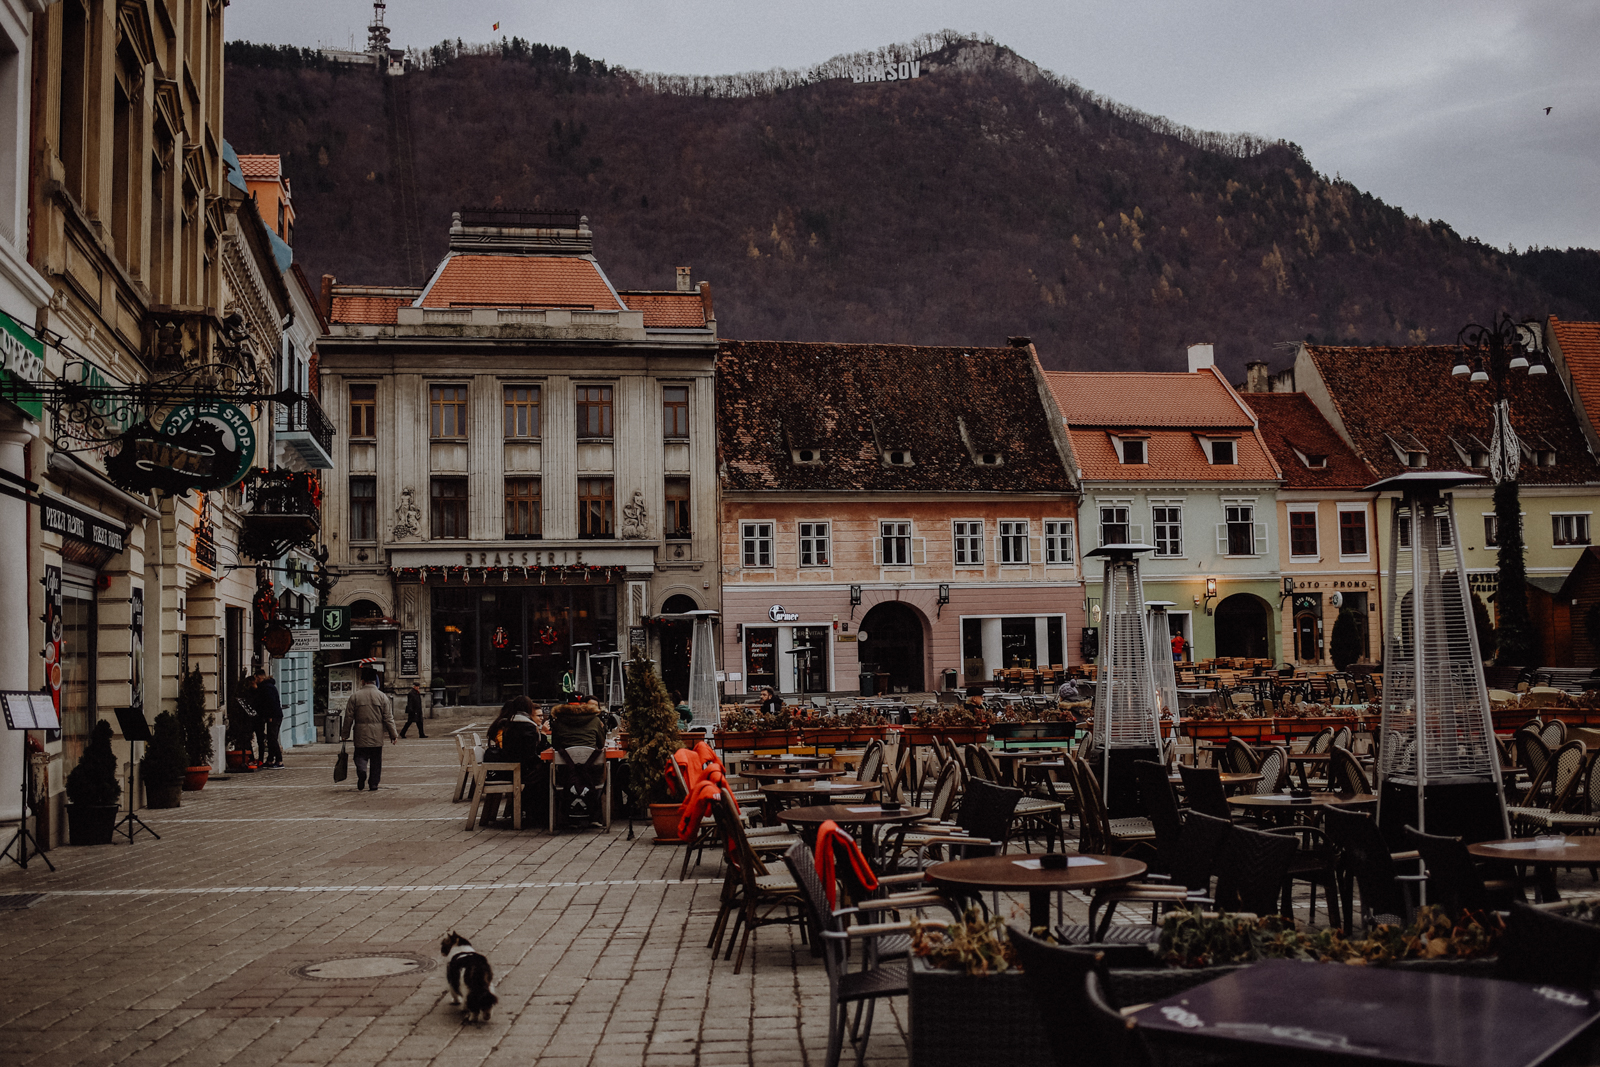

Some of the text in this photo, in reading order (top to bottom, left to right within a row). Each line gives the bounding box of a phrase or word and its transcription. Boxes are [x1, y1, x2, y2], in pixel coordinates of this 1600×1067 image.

[166, 402, 251, 448] COFFEE SHOP
[46, 506, 66, 532] PIZZA
[465, 551, 582, 566] BRASSERIE
[1293, 581, 1320, 589] LOTO
[1333, 581, 1367, 589] PRONO
